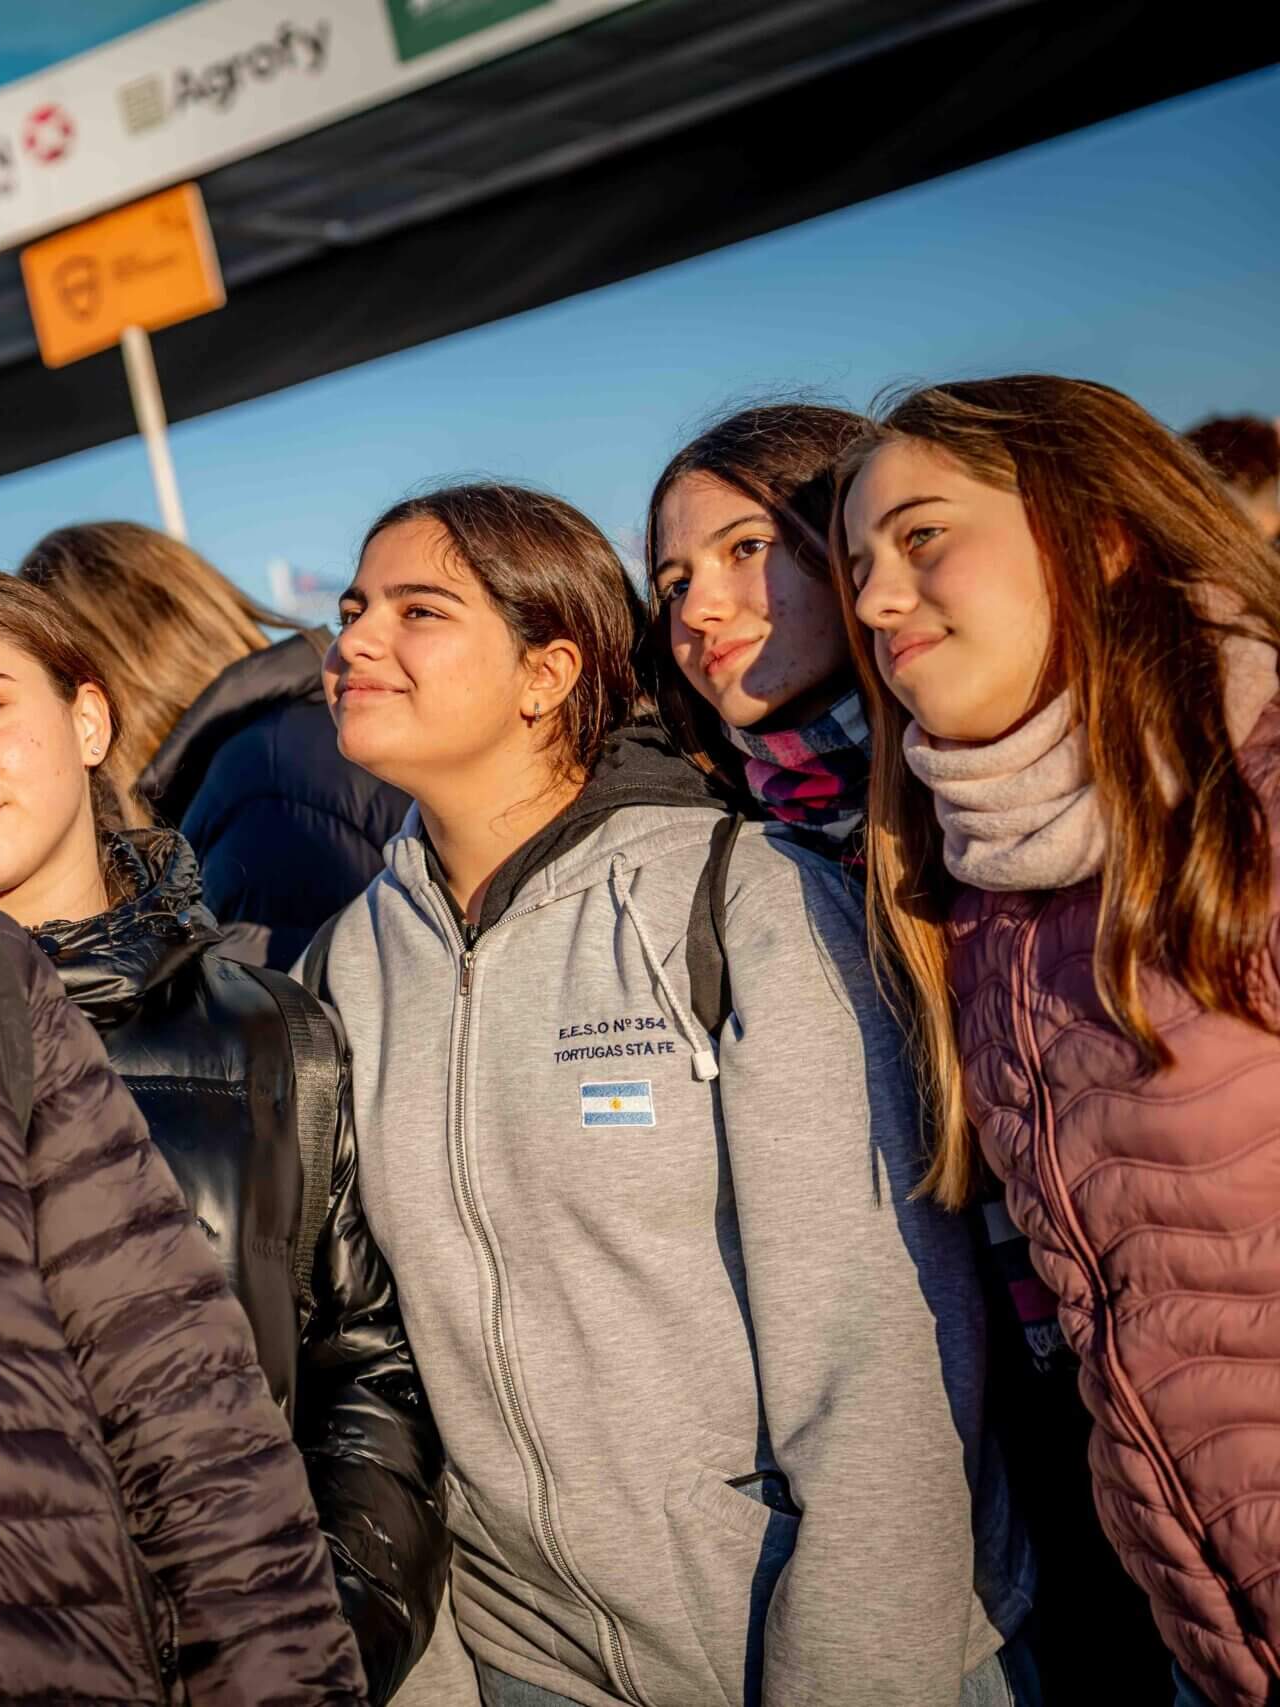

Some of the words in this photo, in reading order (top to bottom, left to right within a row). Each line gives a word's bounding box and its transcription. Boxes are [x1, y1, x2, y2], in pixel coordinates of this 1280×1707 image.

[176, 20, 329, 114] Agrofy
[634, 1017, 667, 1031] 354
[554, 1044, 623, 1063] TORTUGAS
[625, 1042, 654, 1056] STA
[657, 1041, 676, 1054] FE
